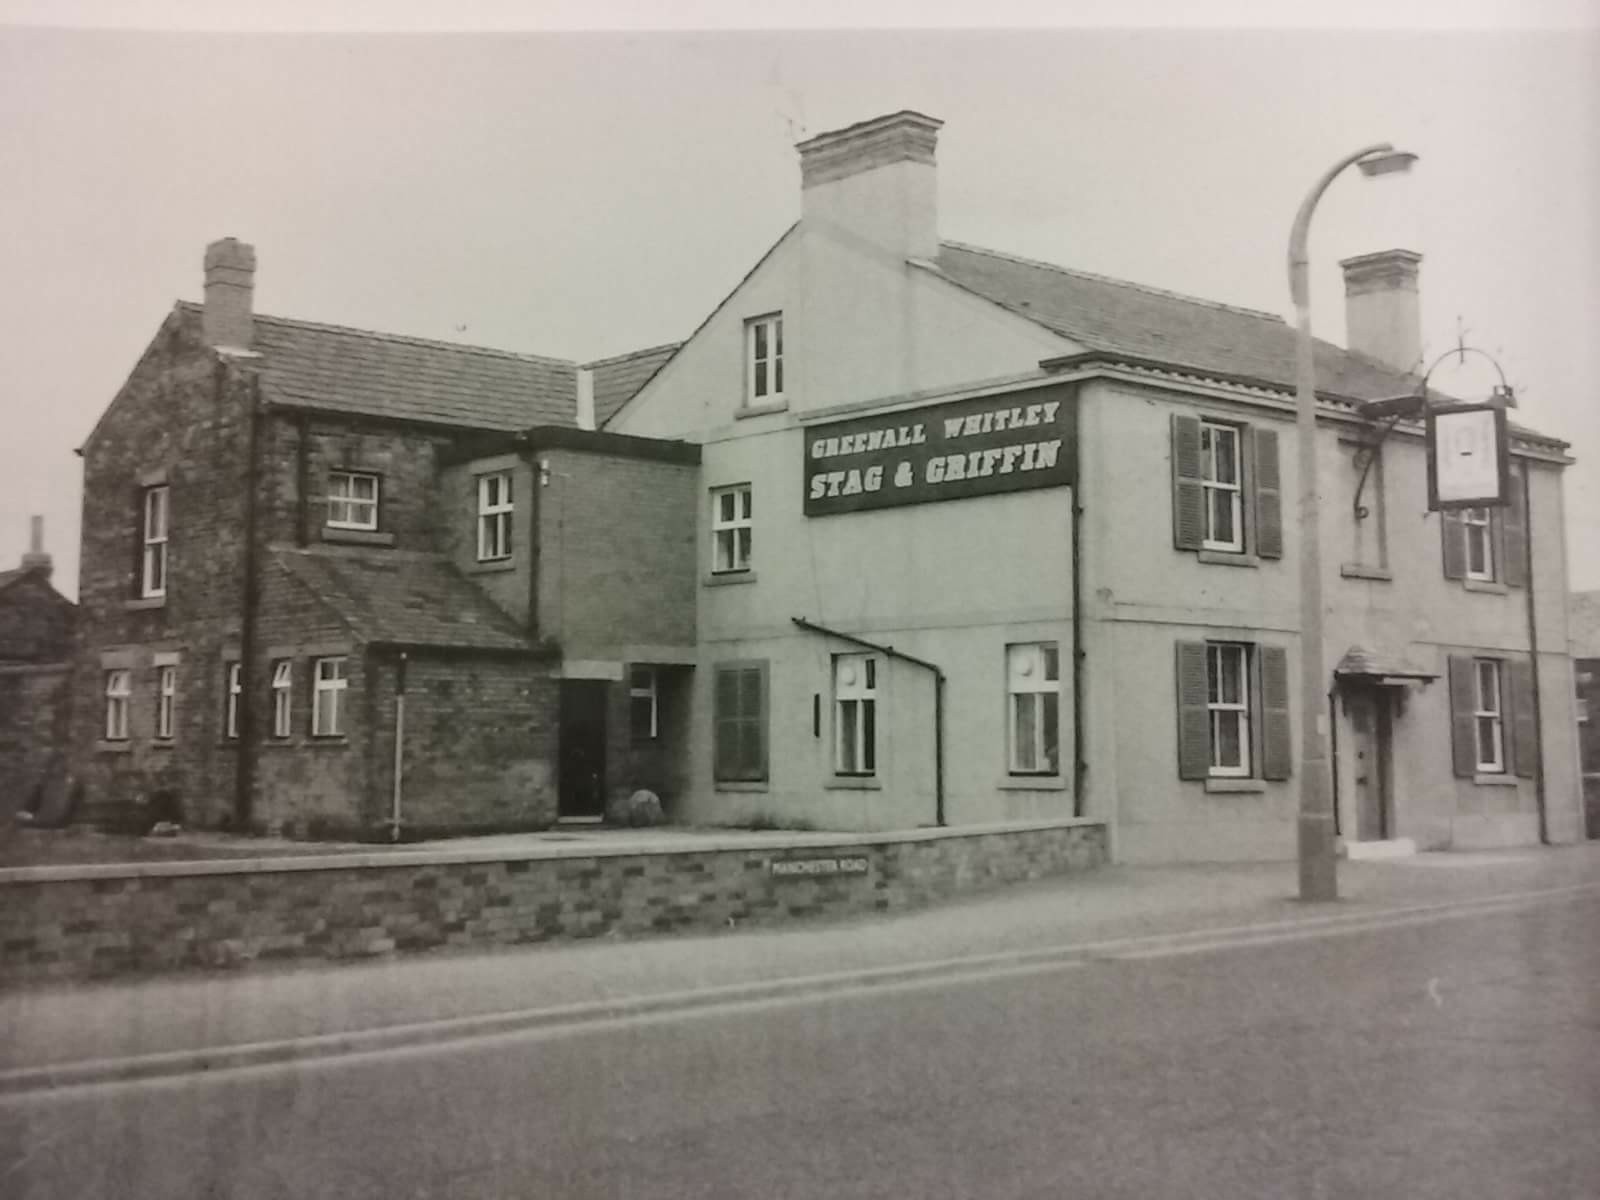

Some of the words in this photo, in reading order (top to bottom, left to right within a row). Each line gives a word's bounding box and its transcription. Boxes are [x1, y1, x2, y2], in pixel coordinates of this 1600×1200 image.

[811, 424, 926, 459] GREENALL
[944, 401, 1060, 439] WHITLEY
[810, 466, 884, 499] STAG
[894, 461, 914, 487] &
[926, 440, 1062, 484] GRIFFIN
[772, 860, 837, 875] MANCHESTER
[840, 858, 867, 872] ROAD
